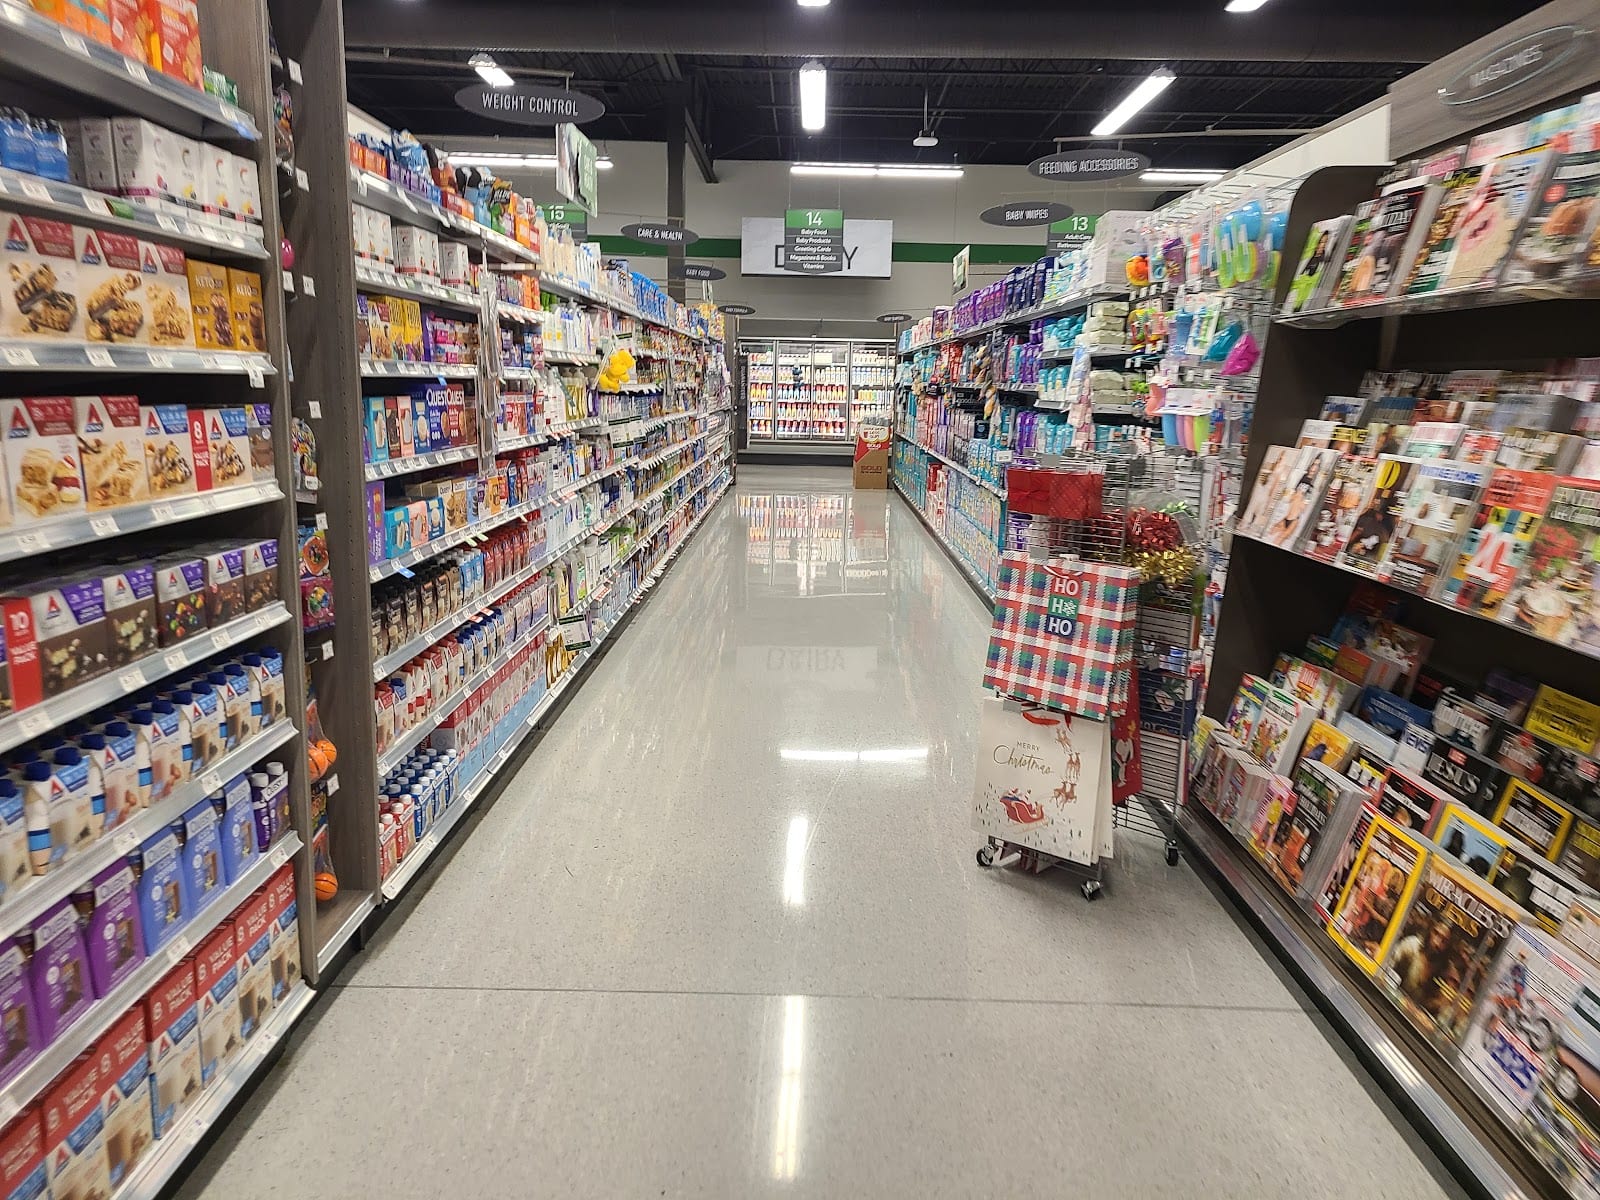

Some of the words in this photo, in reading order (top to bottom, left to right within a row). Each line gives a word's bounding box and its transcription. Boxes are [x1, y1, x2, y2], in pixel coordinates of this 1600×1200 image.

[482, 92, 525, 111] WEIGHT
[529, 96, 578, 117] CONTROL
[1039, 161, 1077, 175] FEEDING
[1079, 158, 1139, 172] ACCESSORIES
[549, 205, 564, 220] 15
[806, 211, 823, 226] 14
[1005, 210, 1024, 221] BABY
[1026, 208, 1048, 219] WIPES
[1071, 216, 1088, 231] 13
[637, 228, 654, 238] CARE
[660, 230, 683, 241] HEALTH
[426, 388, 447, 407] QUEST
[447, 388, 465, 405] QUEST
[193, 421, 203, 440] 8
[1054, 577, 1079, 596] HO
[9, 611, 30, 630] 10
[1048, 616, 1072, 636] HO
[1017, 741, 1041, 751] MERRY
[993, 745, 1055, 775] Christmas
[276, 873, 294, 895] VALUE
[269, 893, 275, 910] 8
[279, 884, 294, 904] PACK
[246, 902, 268, 926] VALUE
[237, 925, 245, 945] 8
[249, 914, 266, 937] PACK
[208, 935, 234, 962] VALUE
[212, 949, 232, 974] PACK
[199, 963, 206, 982] 8
